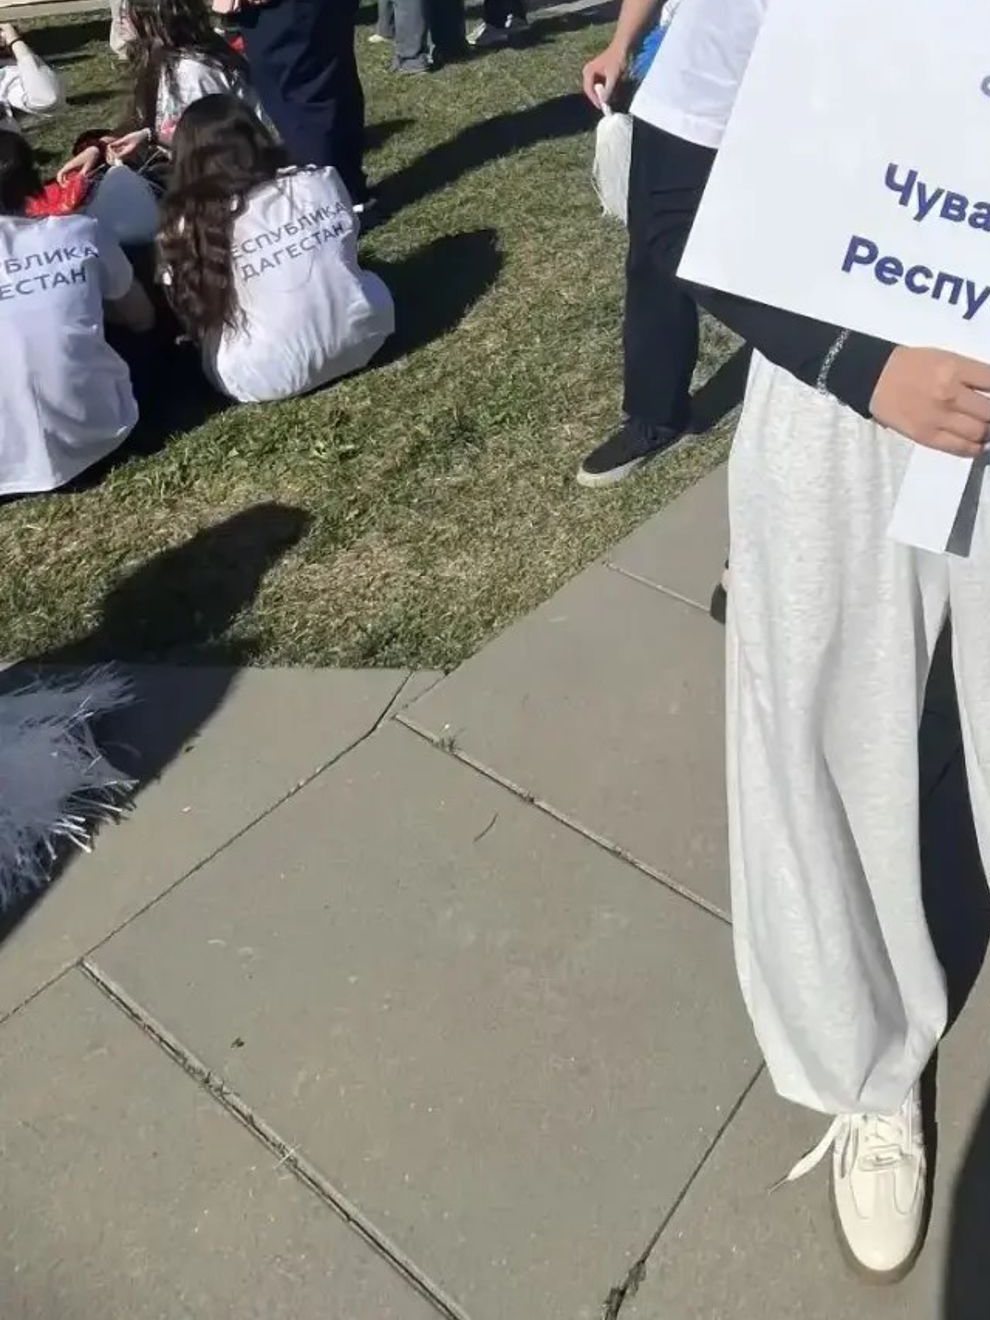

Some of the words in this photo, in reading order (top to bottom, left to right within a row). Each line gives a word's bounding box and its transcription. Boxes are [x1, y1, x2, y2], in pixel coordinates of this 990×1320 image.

[231, 201, 348, 260] ЕСПУБЛИКА
[240, 221, 344, 281] ДАГЕСТАН
[2, 246, 100, 275] БЛИКА
